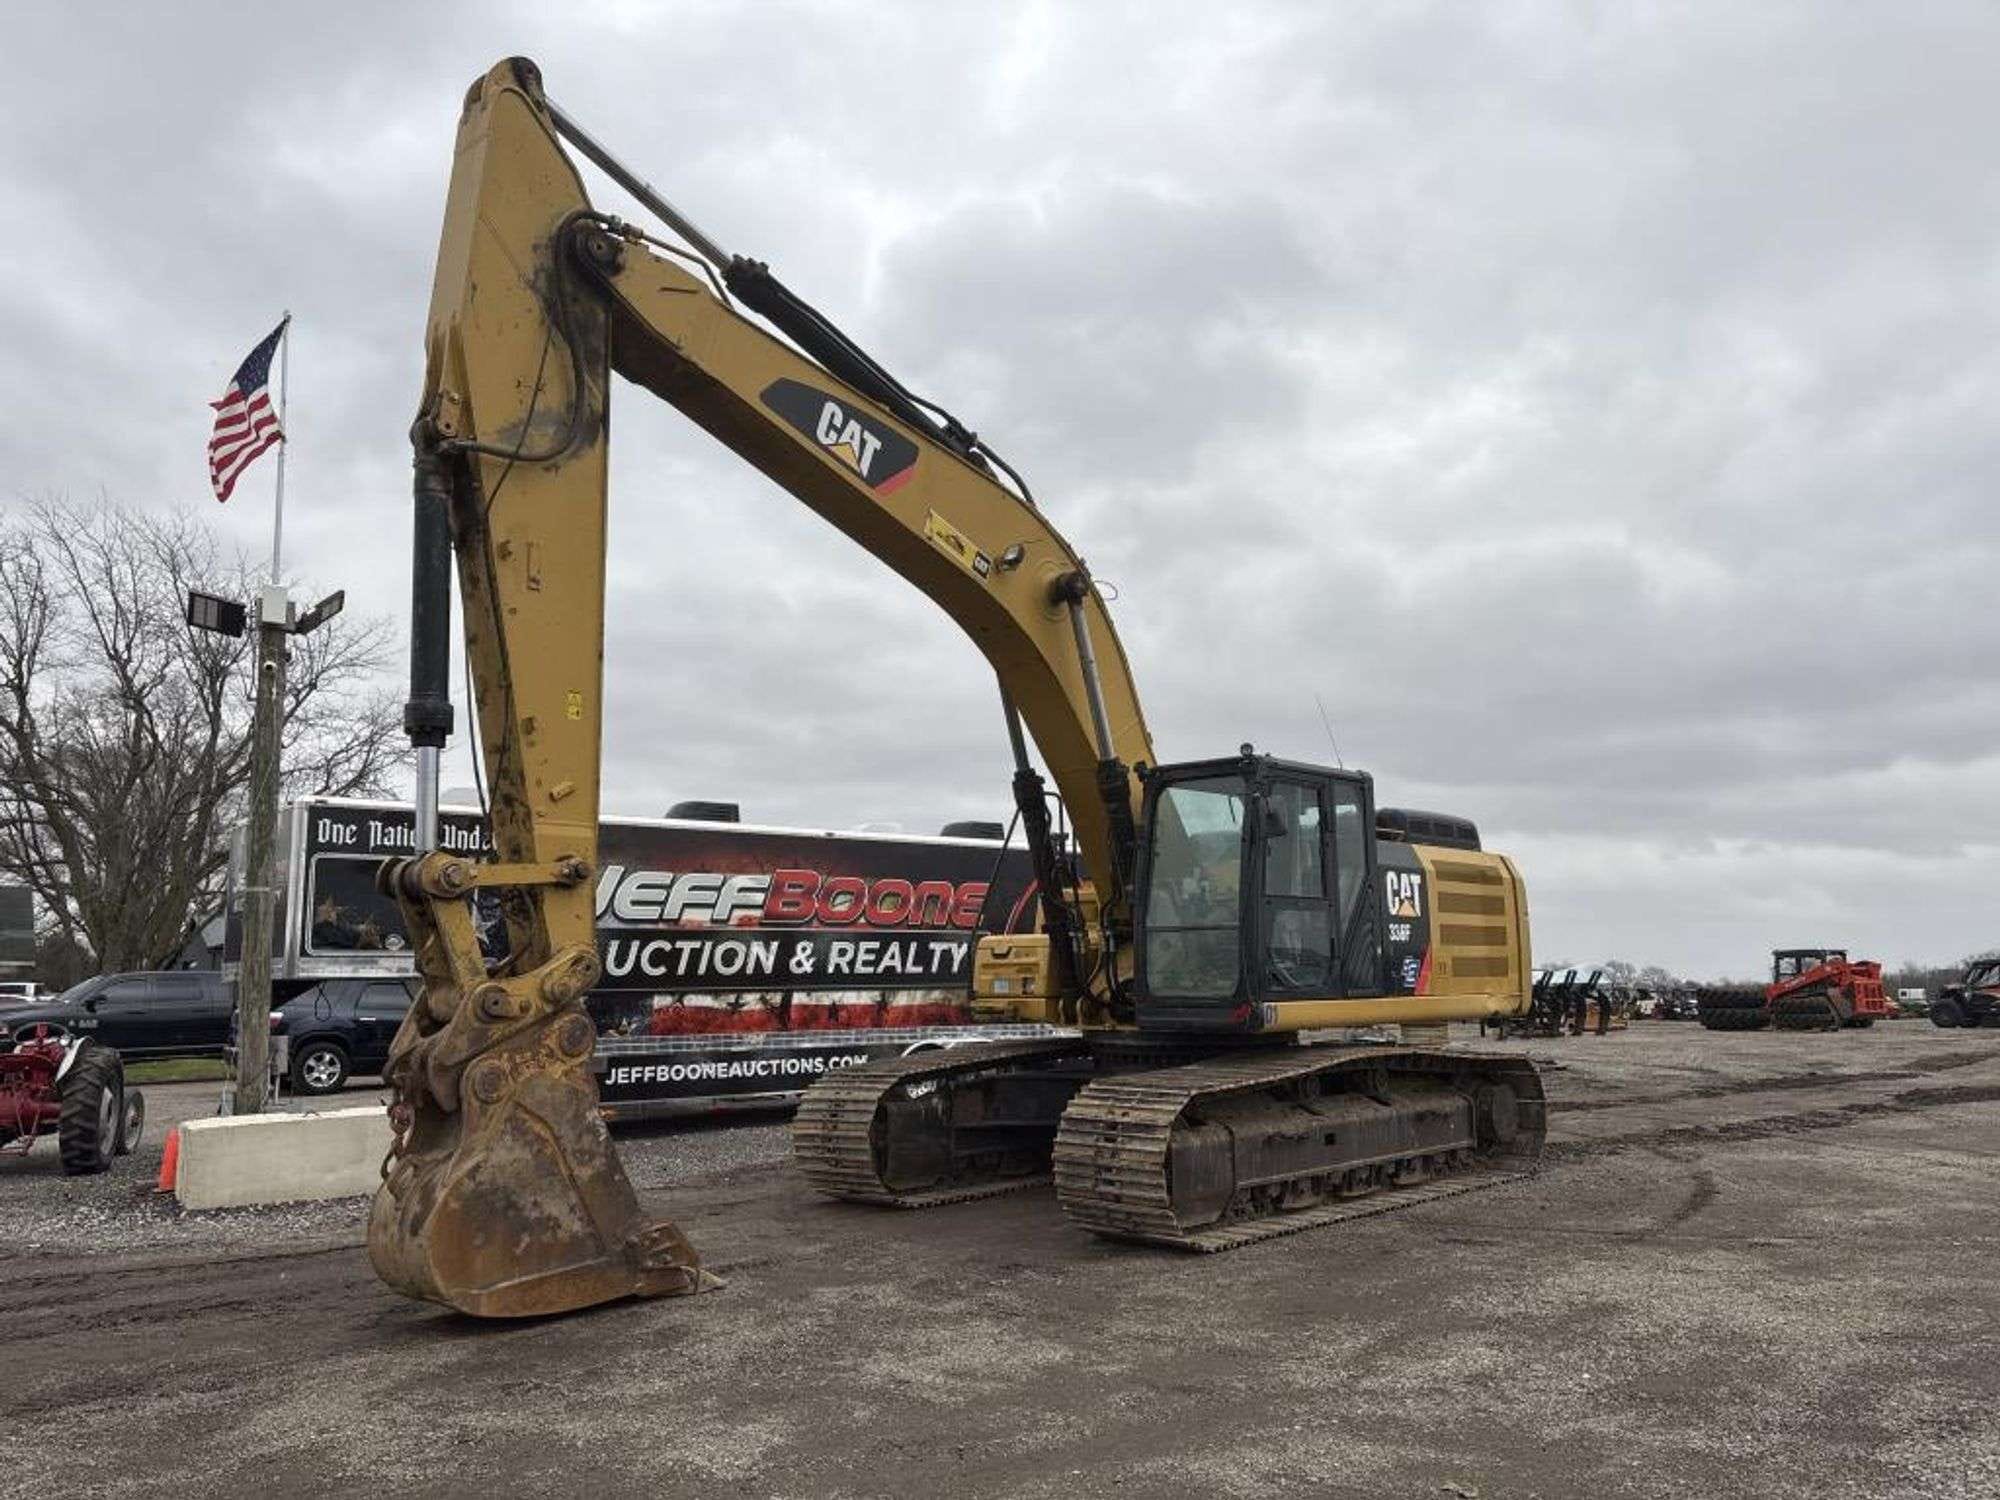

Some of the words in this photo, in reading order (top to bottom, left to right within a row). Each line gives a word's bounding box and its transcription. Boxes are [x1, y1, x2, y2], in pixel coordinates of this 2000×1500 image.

[816, 402, 882, 478] CAT
[317, 818, 357, 845] One
[369, 820, 416, 852] Nati
[1387, 871, 1421, 917] CAT
[605, 939, 779, 976] UCTION
[789, 940, 816, 974] &
[827, 941, 968, 974] REALTY
